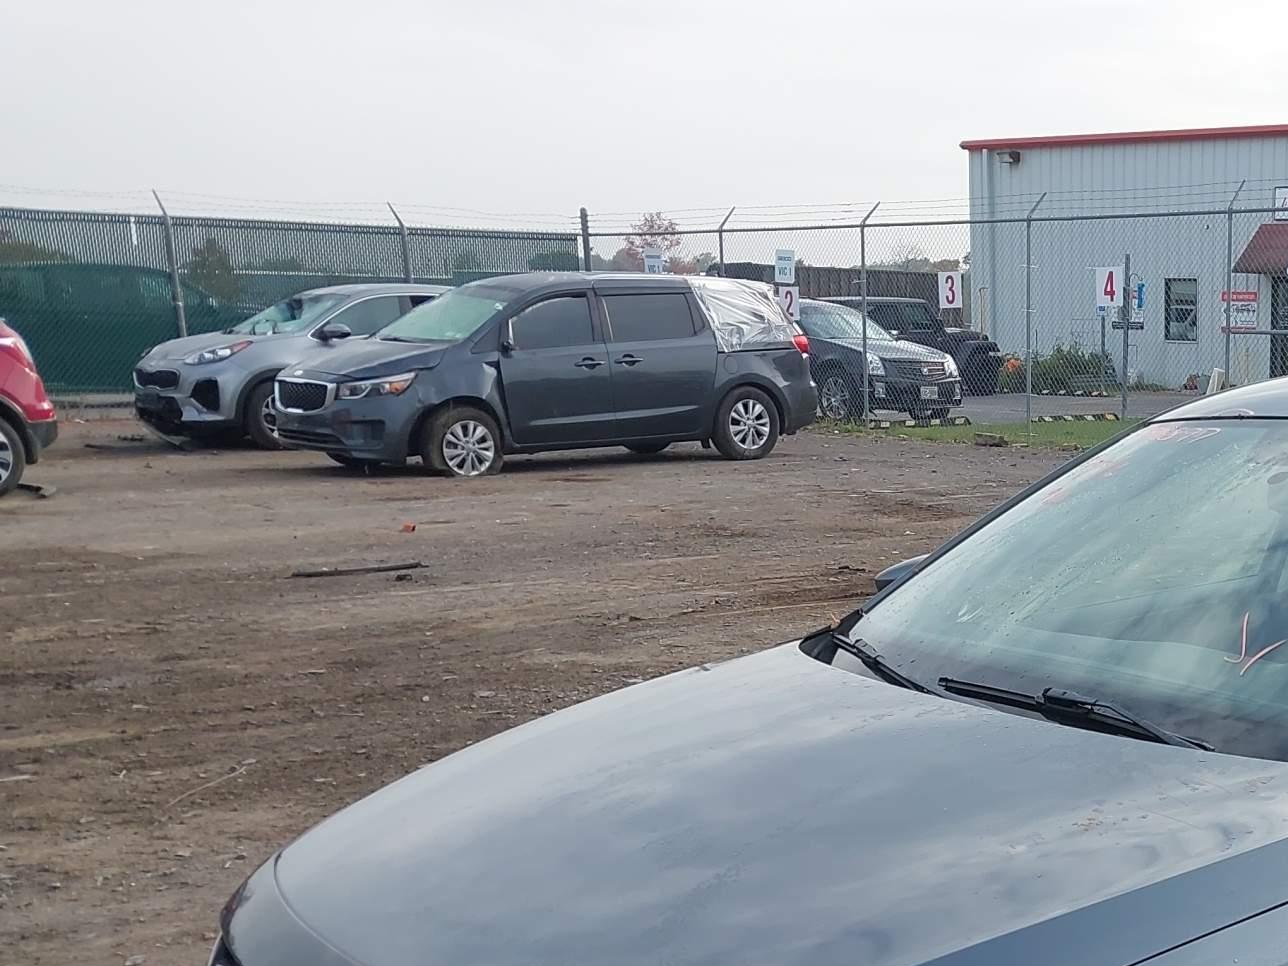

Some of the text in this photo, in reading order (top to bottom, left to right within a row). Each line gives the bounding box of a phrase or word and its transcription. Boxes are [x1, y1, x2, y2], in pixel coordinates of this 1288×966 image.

[778, 267, 787, 276] VIC
[945, 274, 955, 305] 3
[1103, 271, 1116, 302] 4
[784, 290, 794, 317] 2
